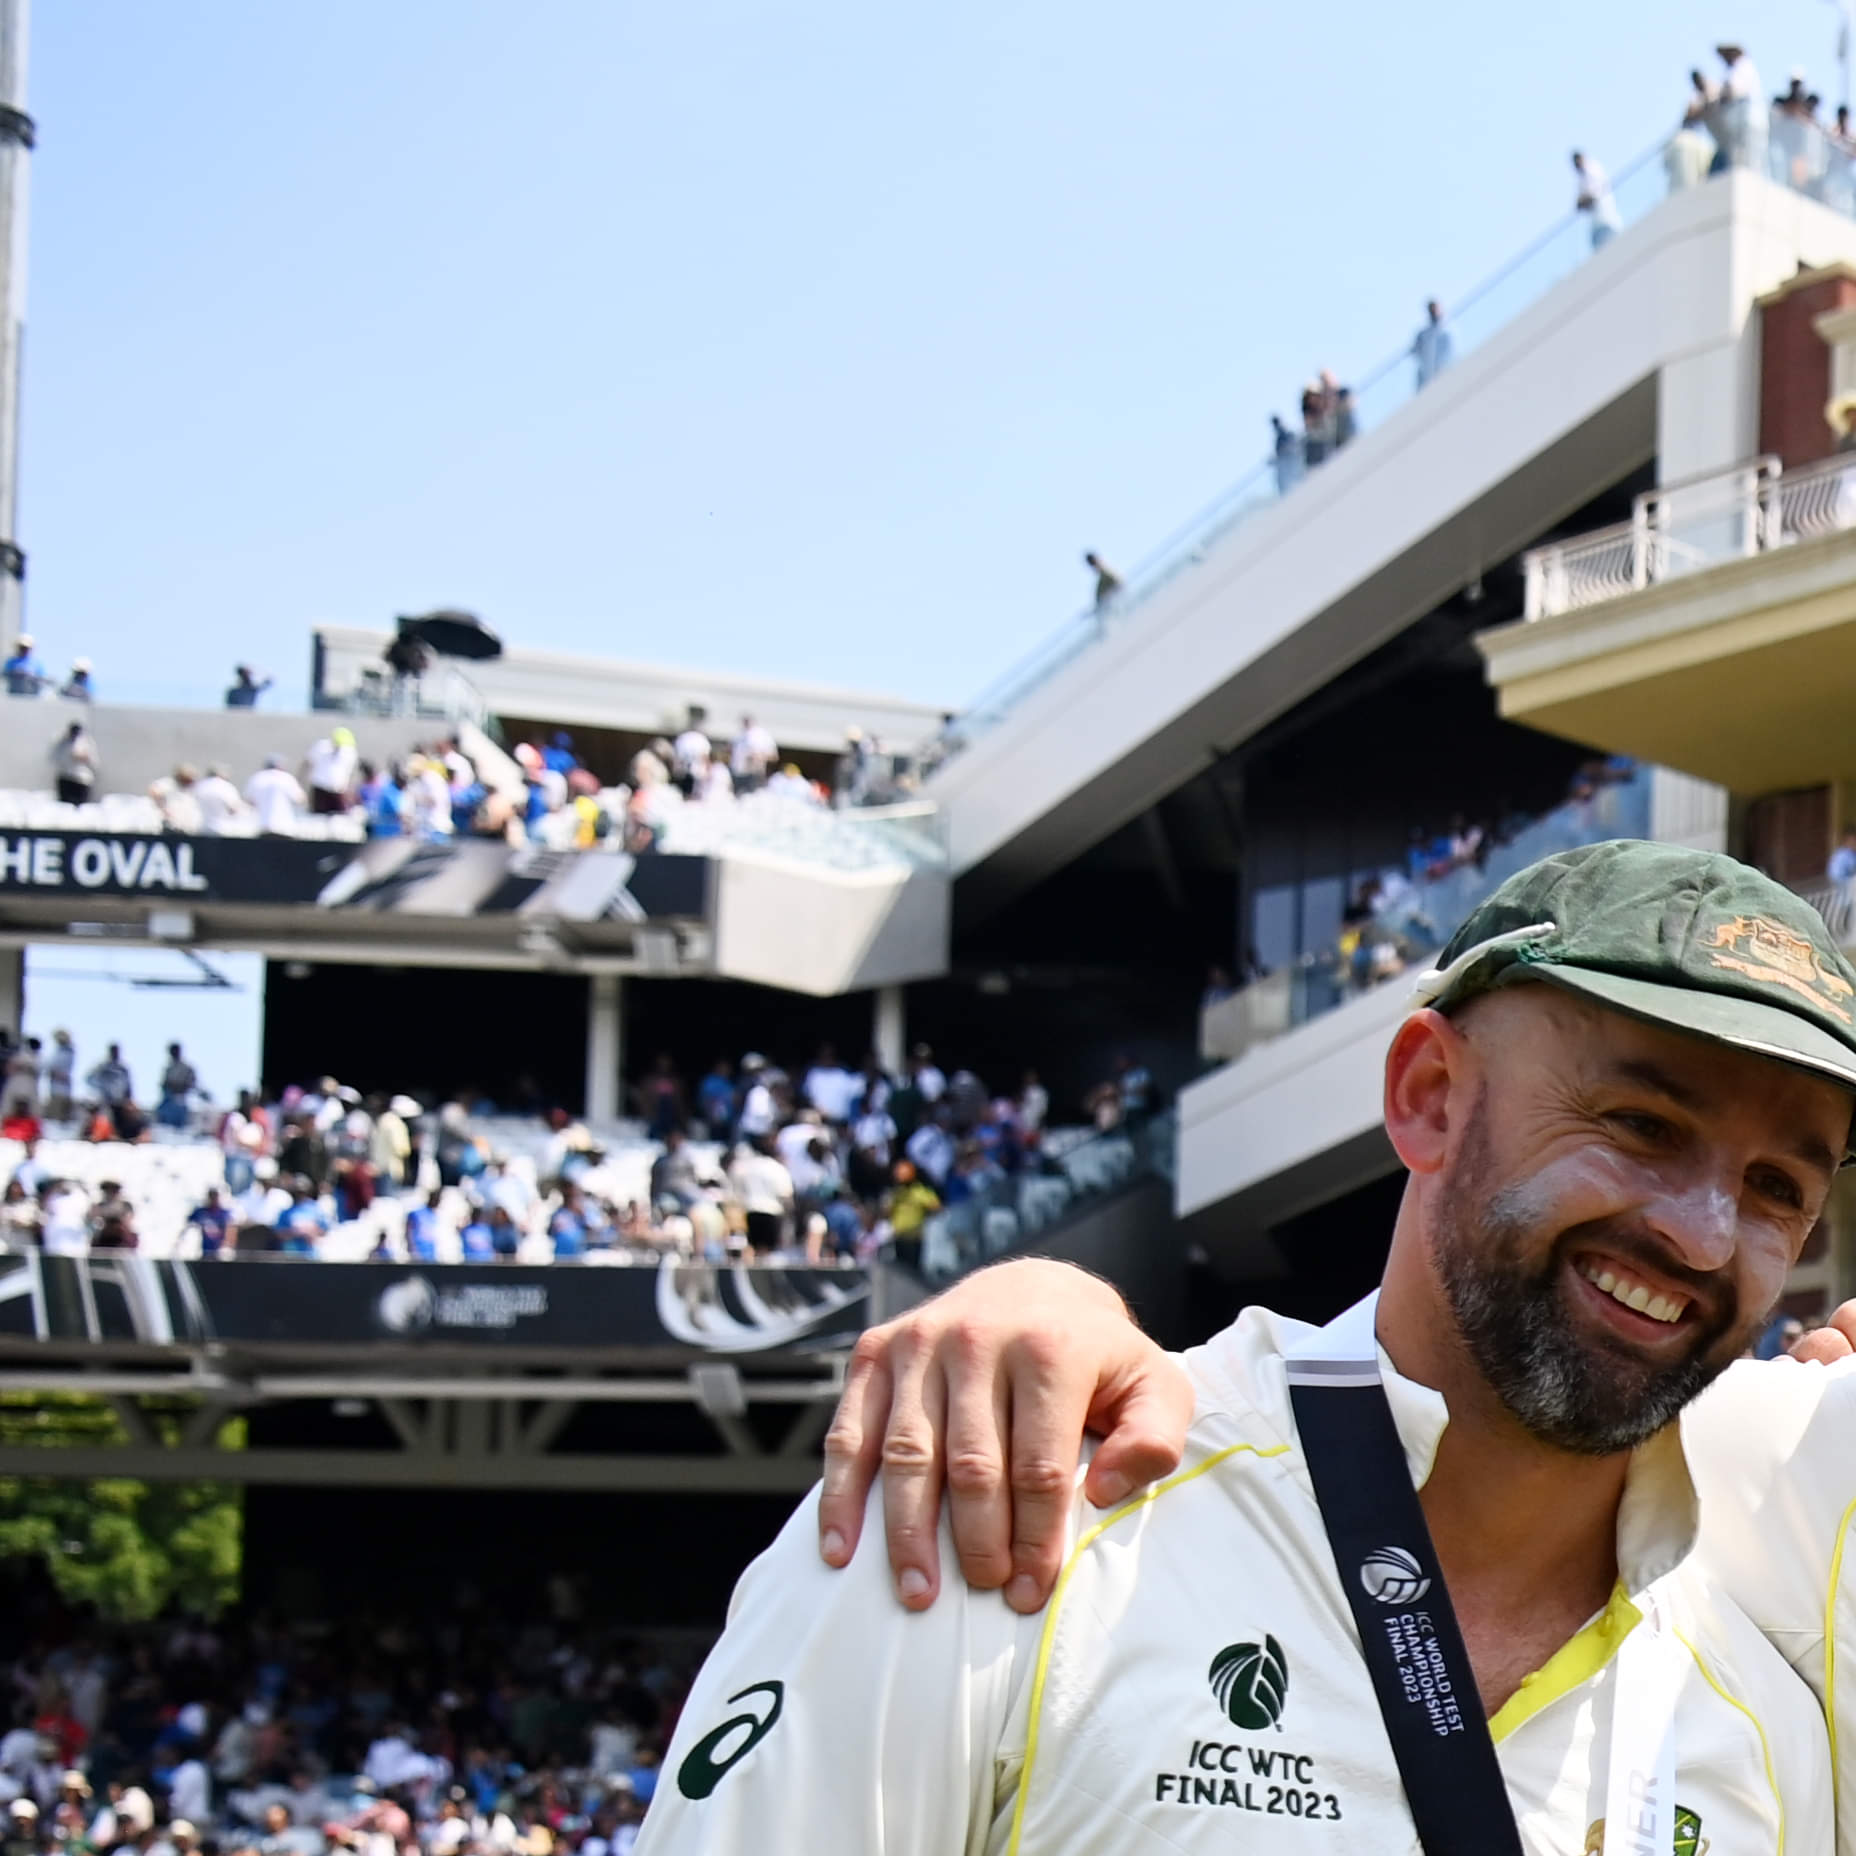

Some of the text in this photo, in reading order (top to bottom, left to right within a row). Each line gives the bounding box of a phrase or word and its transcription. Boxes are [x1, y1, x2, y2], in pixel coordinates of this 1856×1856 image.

[72, 837, 209, 891] OVAL
[1384, 1617, 1422, 1703] FINAL 2023
[1400, 1614, 1449, 1736] CHAMPIONSHIP
[1416, 1611, 1464, 1732] ICC WORLD TEST
[1156, 1774, 1342, 1820] FINAL 2023
[1189, 1740, 1314, 1784] ICC WTC
